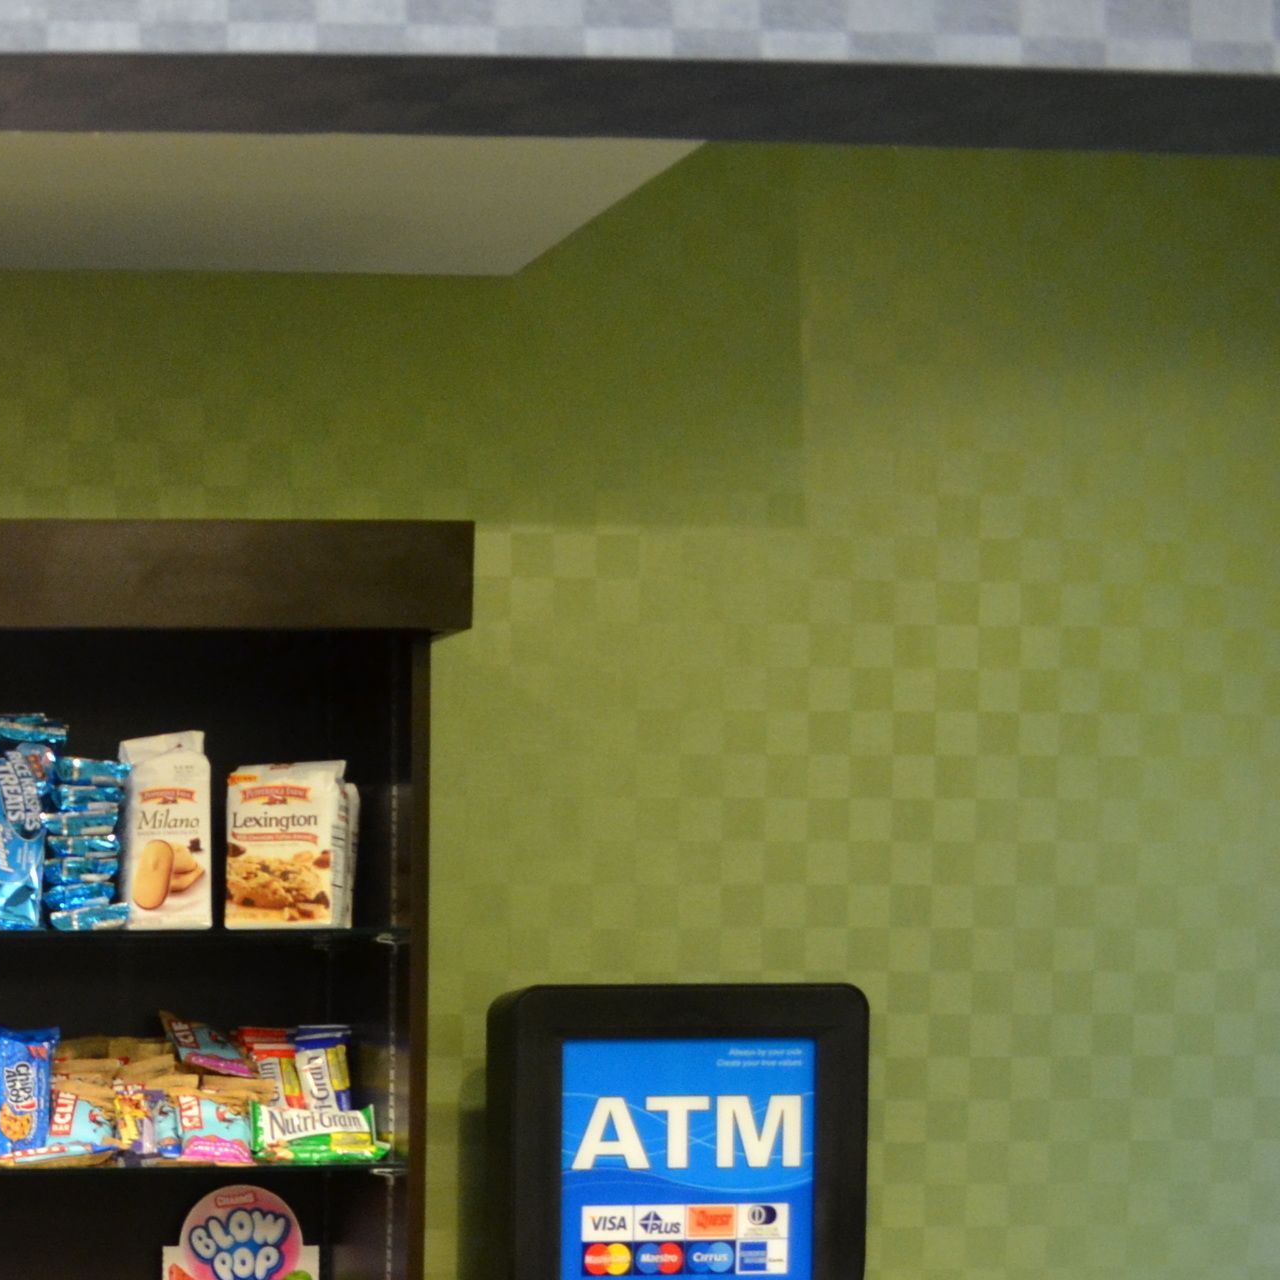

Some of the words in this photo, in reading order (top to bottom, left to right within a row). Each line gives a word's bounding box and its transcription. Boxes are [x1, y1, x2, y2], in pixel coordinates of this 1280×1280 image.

[139, 810, 200, 831] Milano
[232, 811, 318, 830] Lexington
[16, 1063, 33, 1102] Chips
[268, 1110, 362, 1141] Nutri-Grain
[571, 1093, 802, 1170] ATM
[190, 1208, 288, 1259] BLOW
[591, 1216, 627, 1231] VISA
[649, 1222, 681, 1235] PLUS
[640, 1252, 678, 1263] Maestro
[692, 1251, 729, 1263] Cirrus
